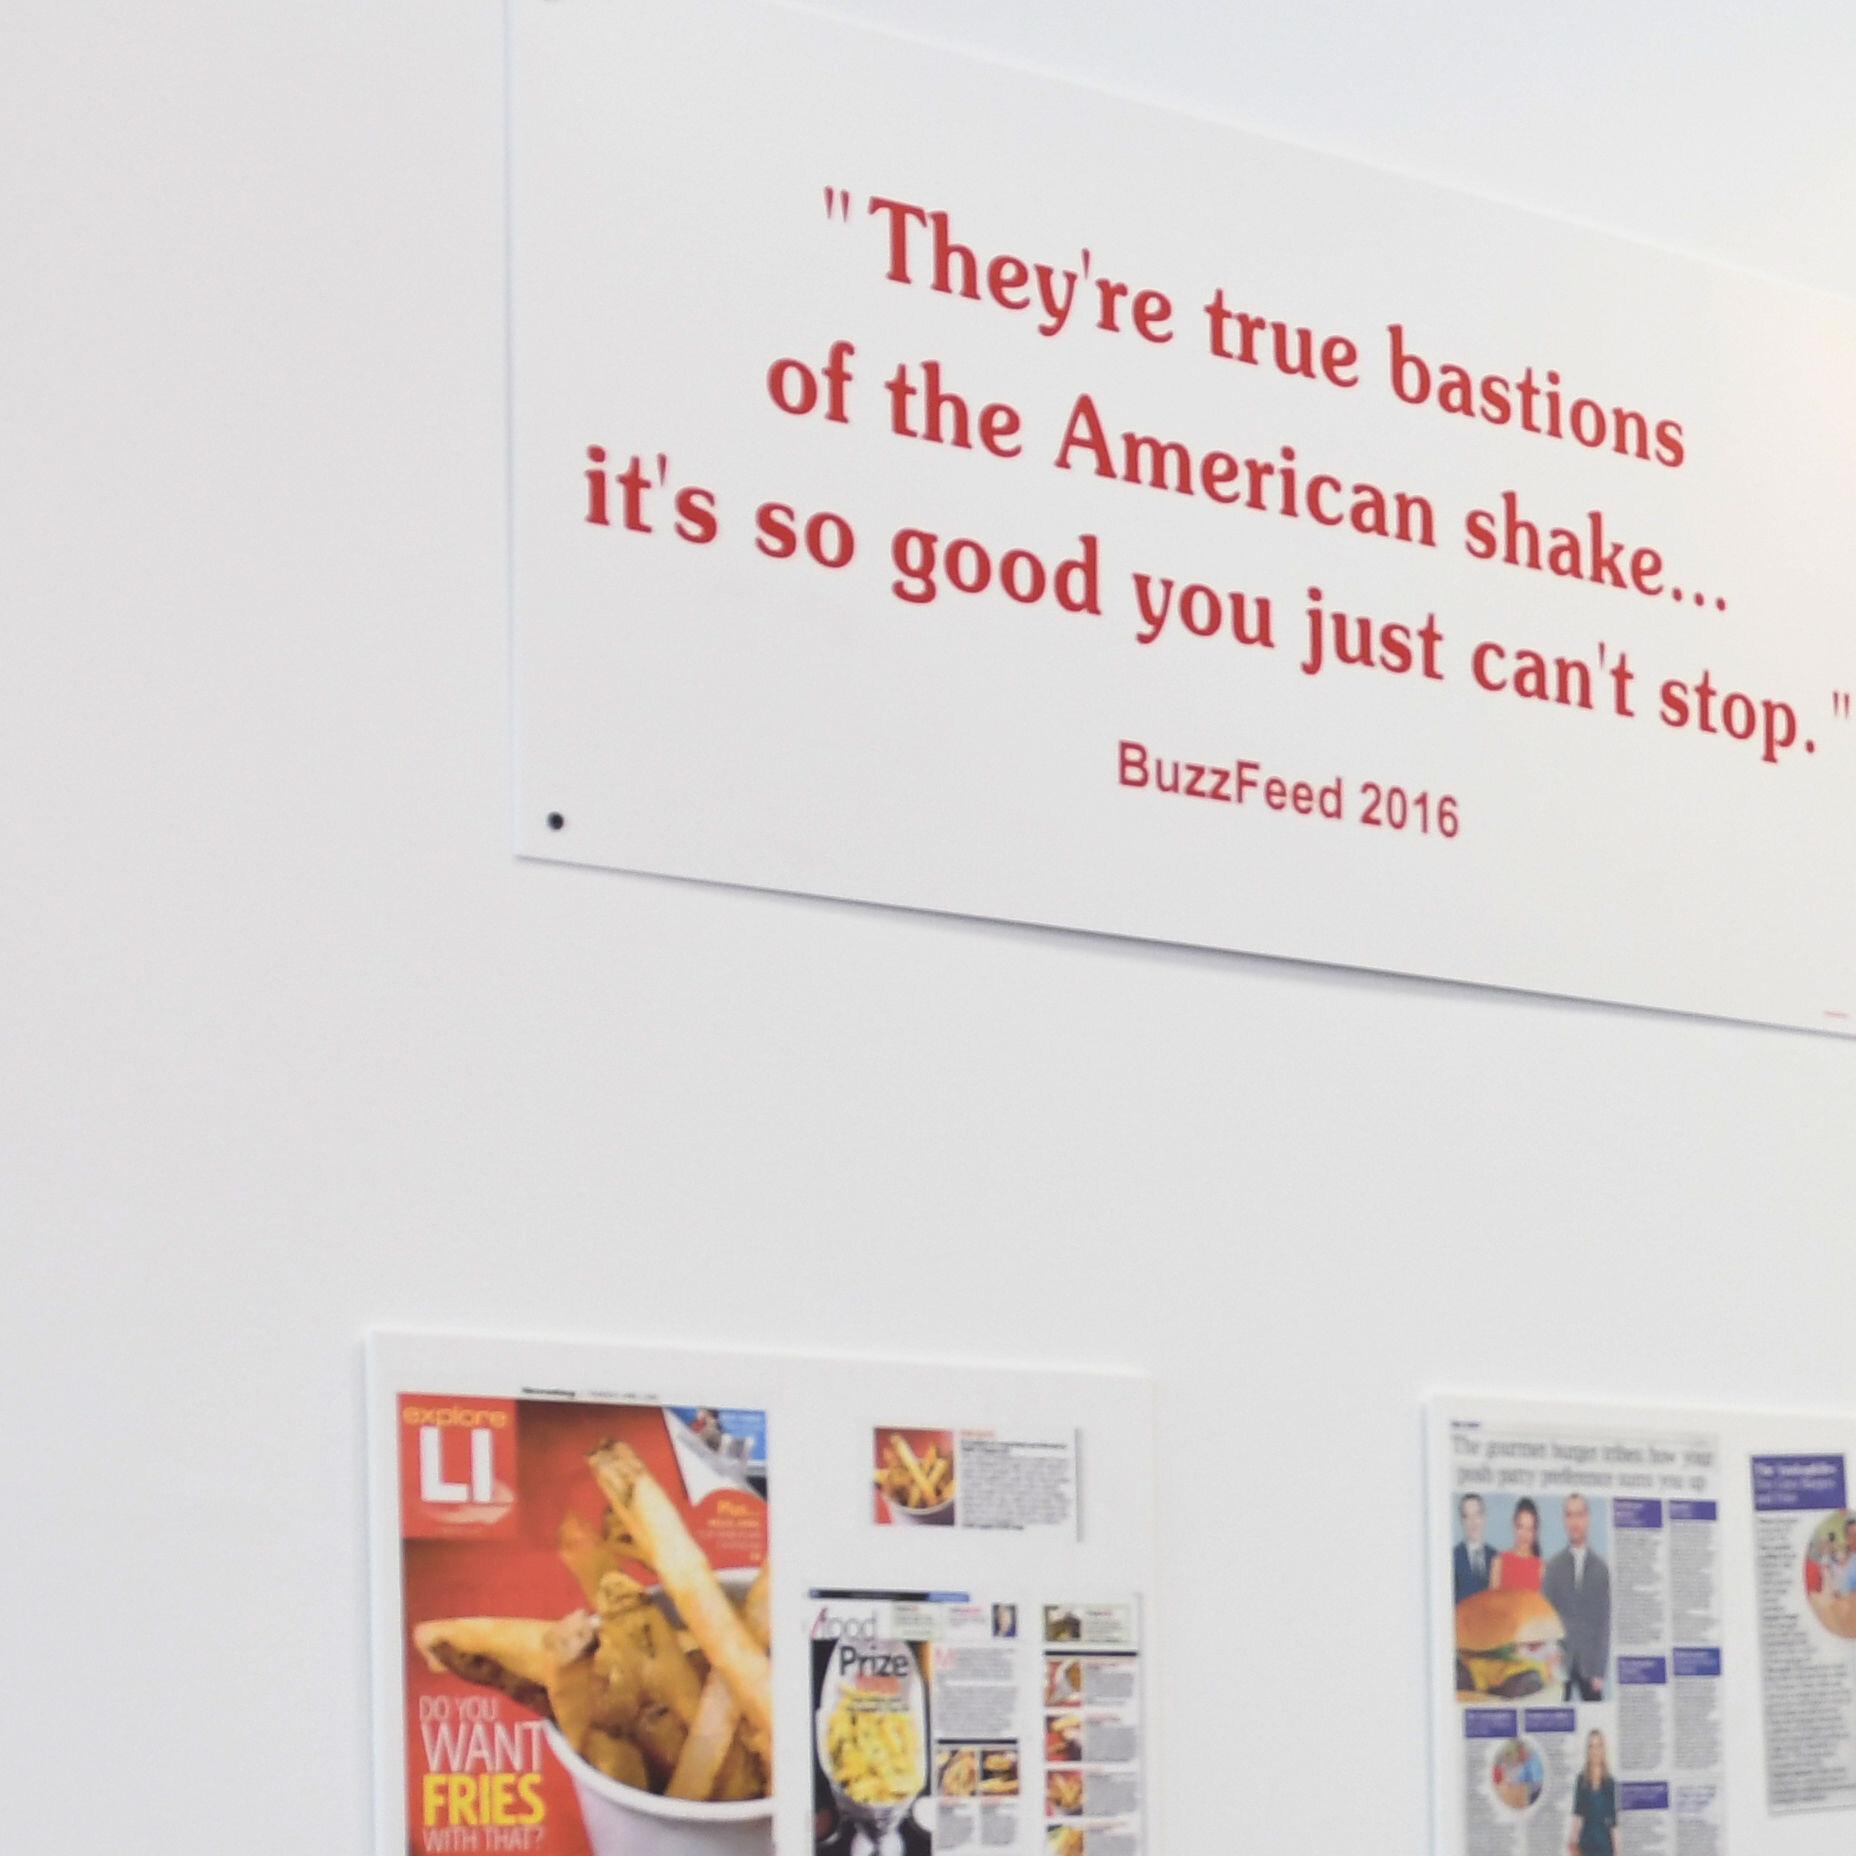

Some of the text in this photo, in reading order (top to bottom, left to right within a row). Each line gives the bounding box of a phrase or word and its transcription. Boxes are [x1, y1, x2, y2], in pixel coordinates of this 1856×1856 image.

[1203, 288, 1361, 390] true
[1387, 322, 1687, 470] bastions
[766, 339, 1729, 613] of the American shake...
[583, 444, 722, 547] it's
[754, 500, 858, 571] so
[891, 526, 1103, 618] good
[1131, 571, 1276, 650] you
[1300, 585, 1445, 682] just
[1471, 638, 1635, 719] can't
[1118, 739, 1461, 840] BuzzFeed 2016
[403, 1404, 508, 1429] explore
[420, 1425, 493, 1503] LI
[839, 1645, 910, 1677] Prize
[419, 1695, 498, 1722] DO YOU
[420, 1722, 544, 1773] WANT
[422, 1772, 546, 1827] FRIES
[423, 1826, 544, 1852] WITH THAT?
